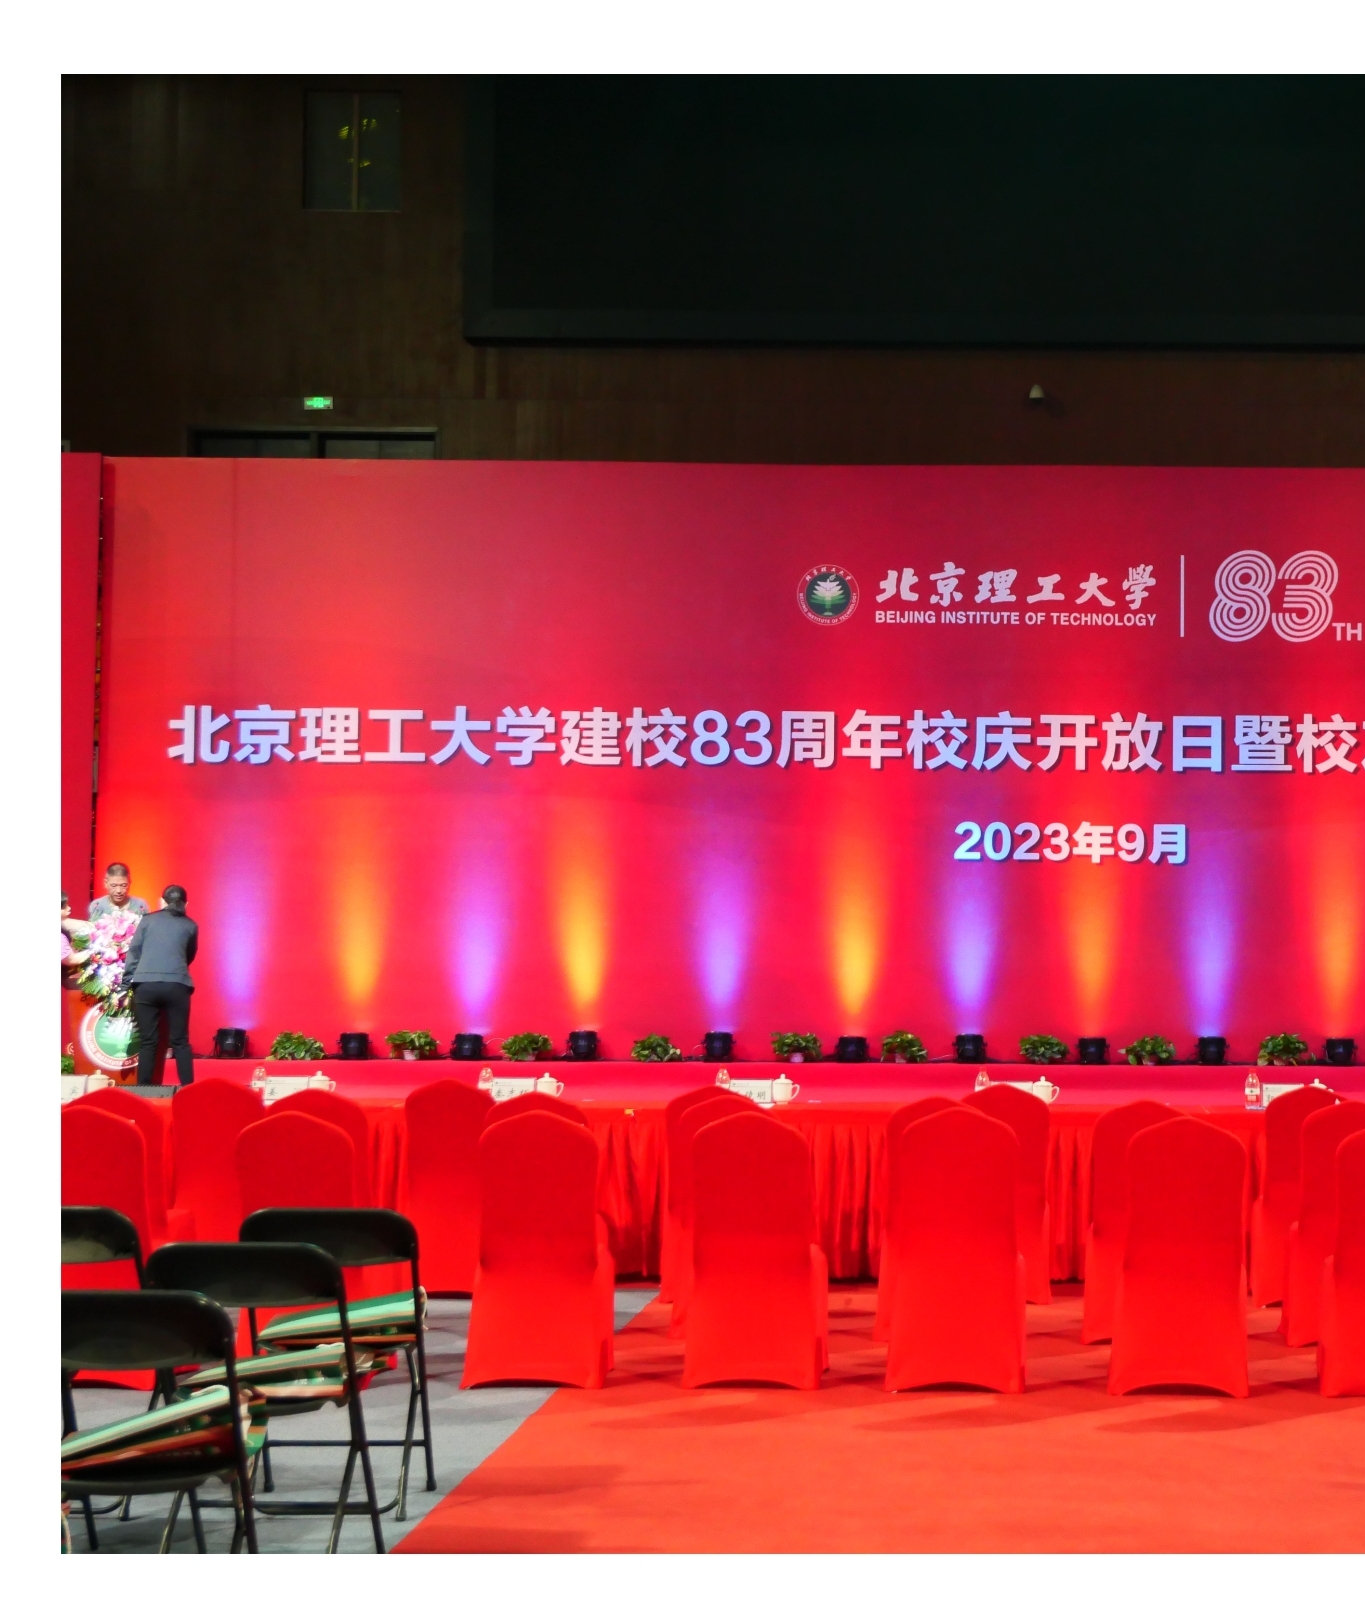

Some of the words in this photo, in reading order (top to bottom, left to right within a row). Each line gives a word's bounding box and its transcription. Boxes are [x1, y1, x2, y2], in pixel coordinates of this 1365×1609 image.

[875, 610, 938, 625] BEIJING
[940, 611, 1020, 625] INSTITUTE
[1024, 611, 1047, 626] OF
[1051, 612, 1157, 627] TECHNOLOGY
[953, 821, 1187, 865] 2023年9月
